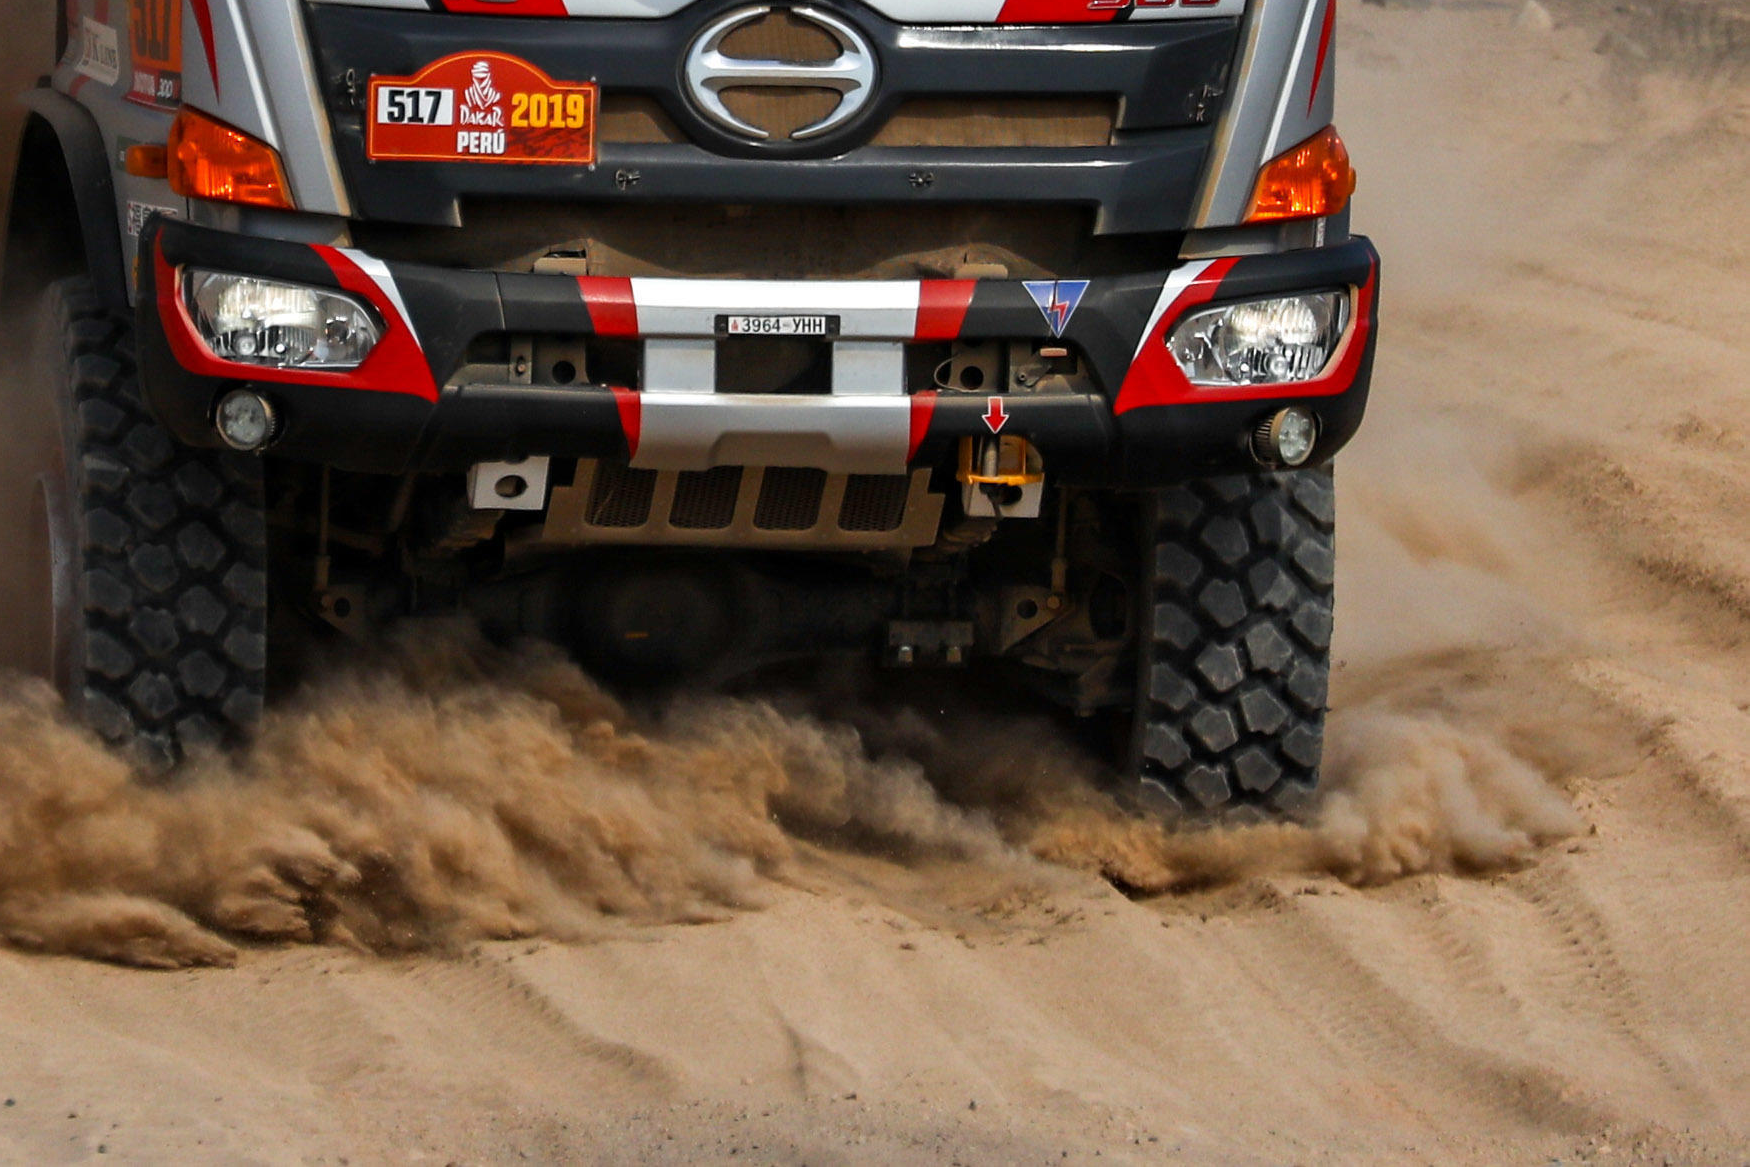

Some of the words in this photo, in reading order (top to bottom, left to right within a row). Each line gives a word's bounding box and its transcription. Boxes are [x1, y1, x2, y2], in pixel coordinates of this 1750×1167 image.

[387, 89, 442, 124] 517
[459, 104, 505, 128] DAKAR
[510, 92, 585, 129] 2019
[456, 129, 506, 155] PERÚ
